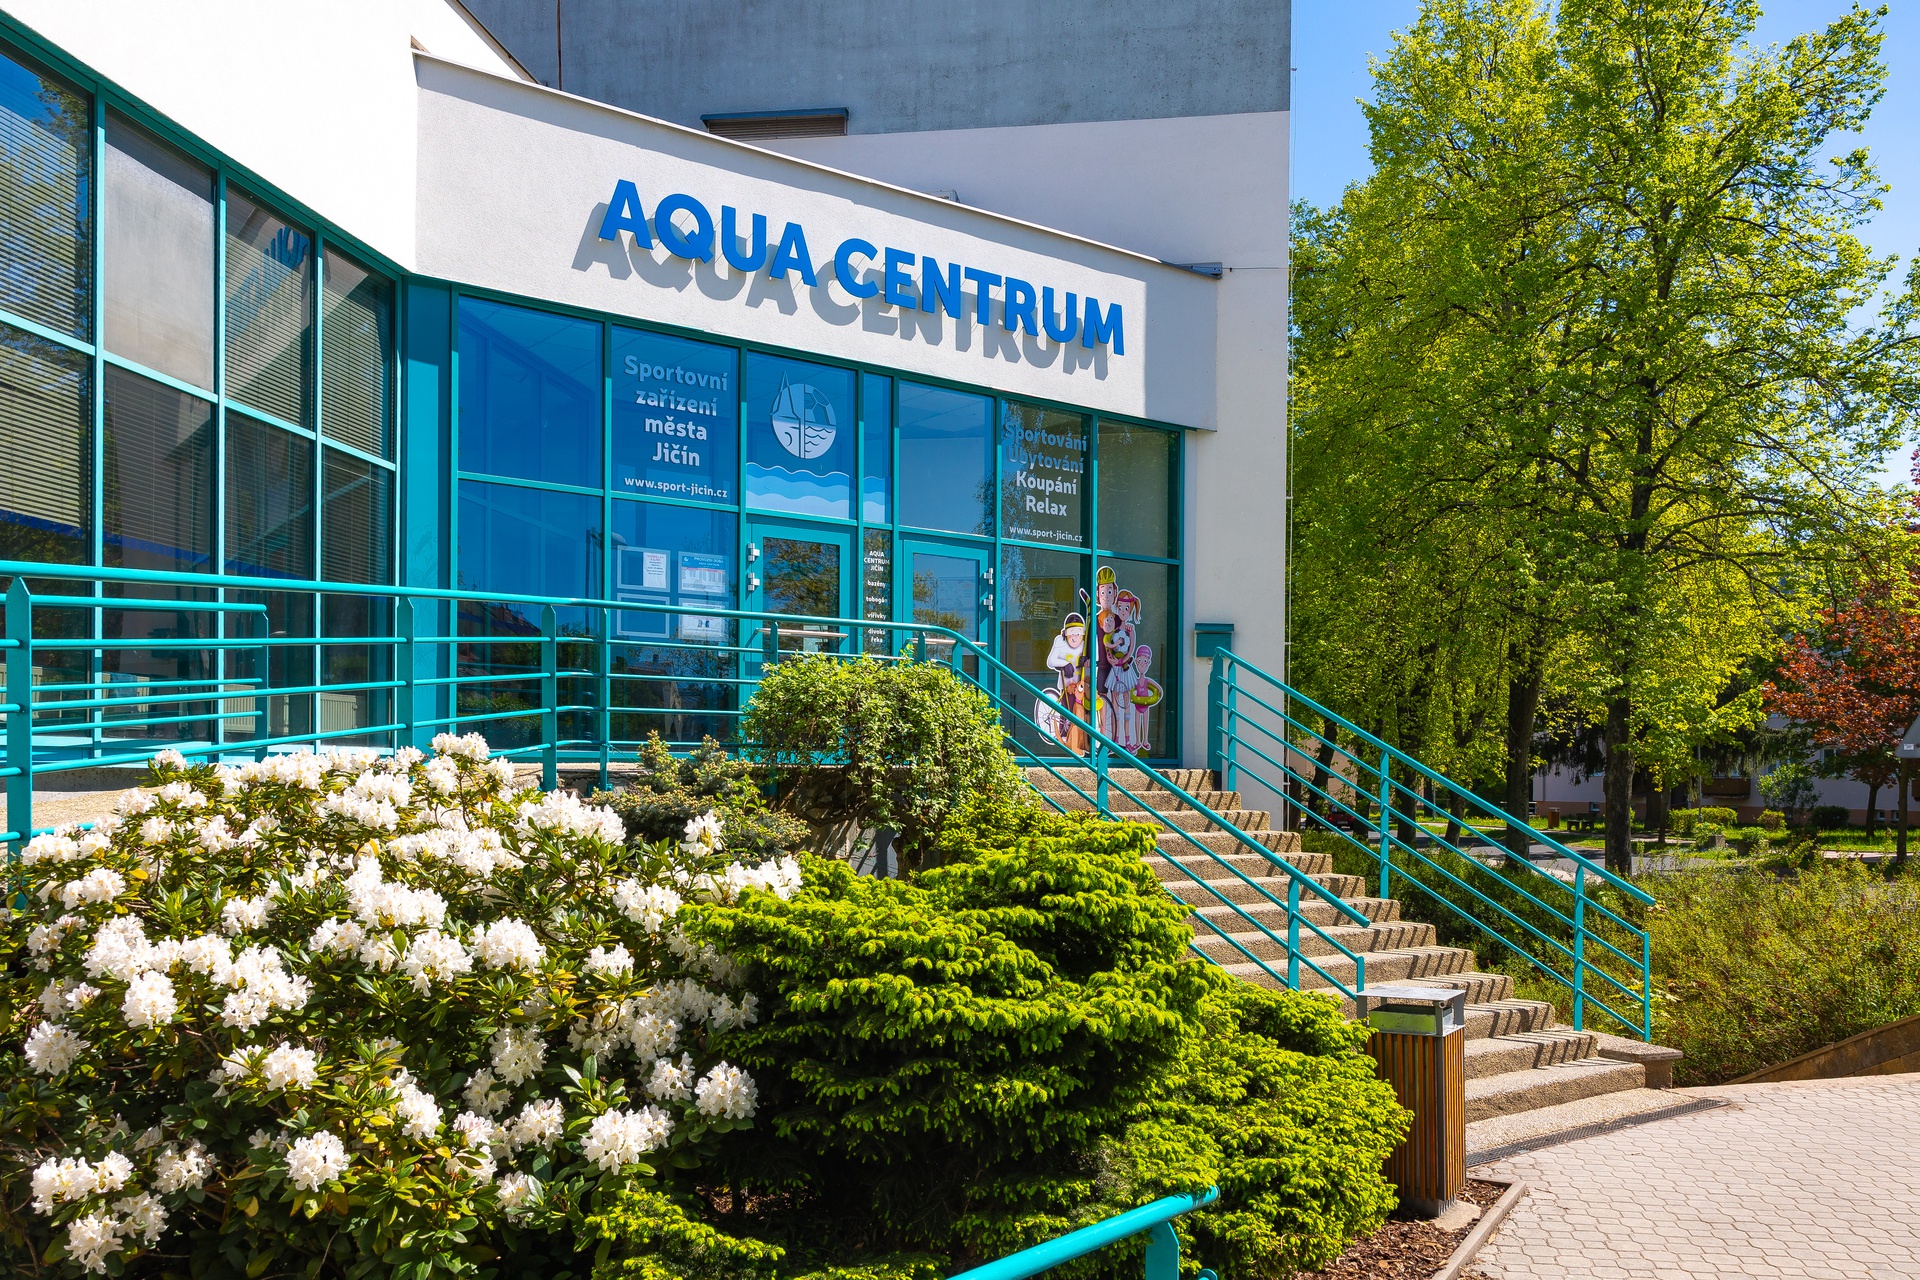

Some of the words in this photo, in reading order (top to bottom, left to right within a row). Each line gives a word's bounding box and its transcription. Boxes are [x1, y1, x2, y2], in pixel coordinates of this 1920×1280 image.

[598, 179, 817, 288] AQUA
[834, 237, 1125, 356] CENTRUM
[624, 355, 728, 391] Sportovní
[635, 387, 717, 416] zařízení
[644, 415, 707, 440] města
[1005, 421, 1087, 452] Sportování
[652, 442, 700, 467] Jičín
[1009, 446, 1084, 474] Ubytování
[624, 476, 728, 498] www.sport-jicin.cz
[1016, 470, 1077, 495] Koupání
[1026, 495, 1067, 517] Relax
[1009, 526, 1083, 543] www.sport-jicin.cz
[863, 557, 890, 565] CENTRUM
[869, 550, 885, 558] AQUA
[867, 580, 886, 589] bazény
